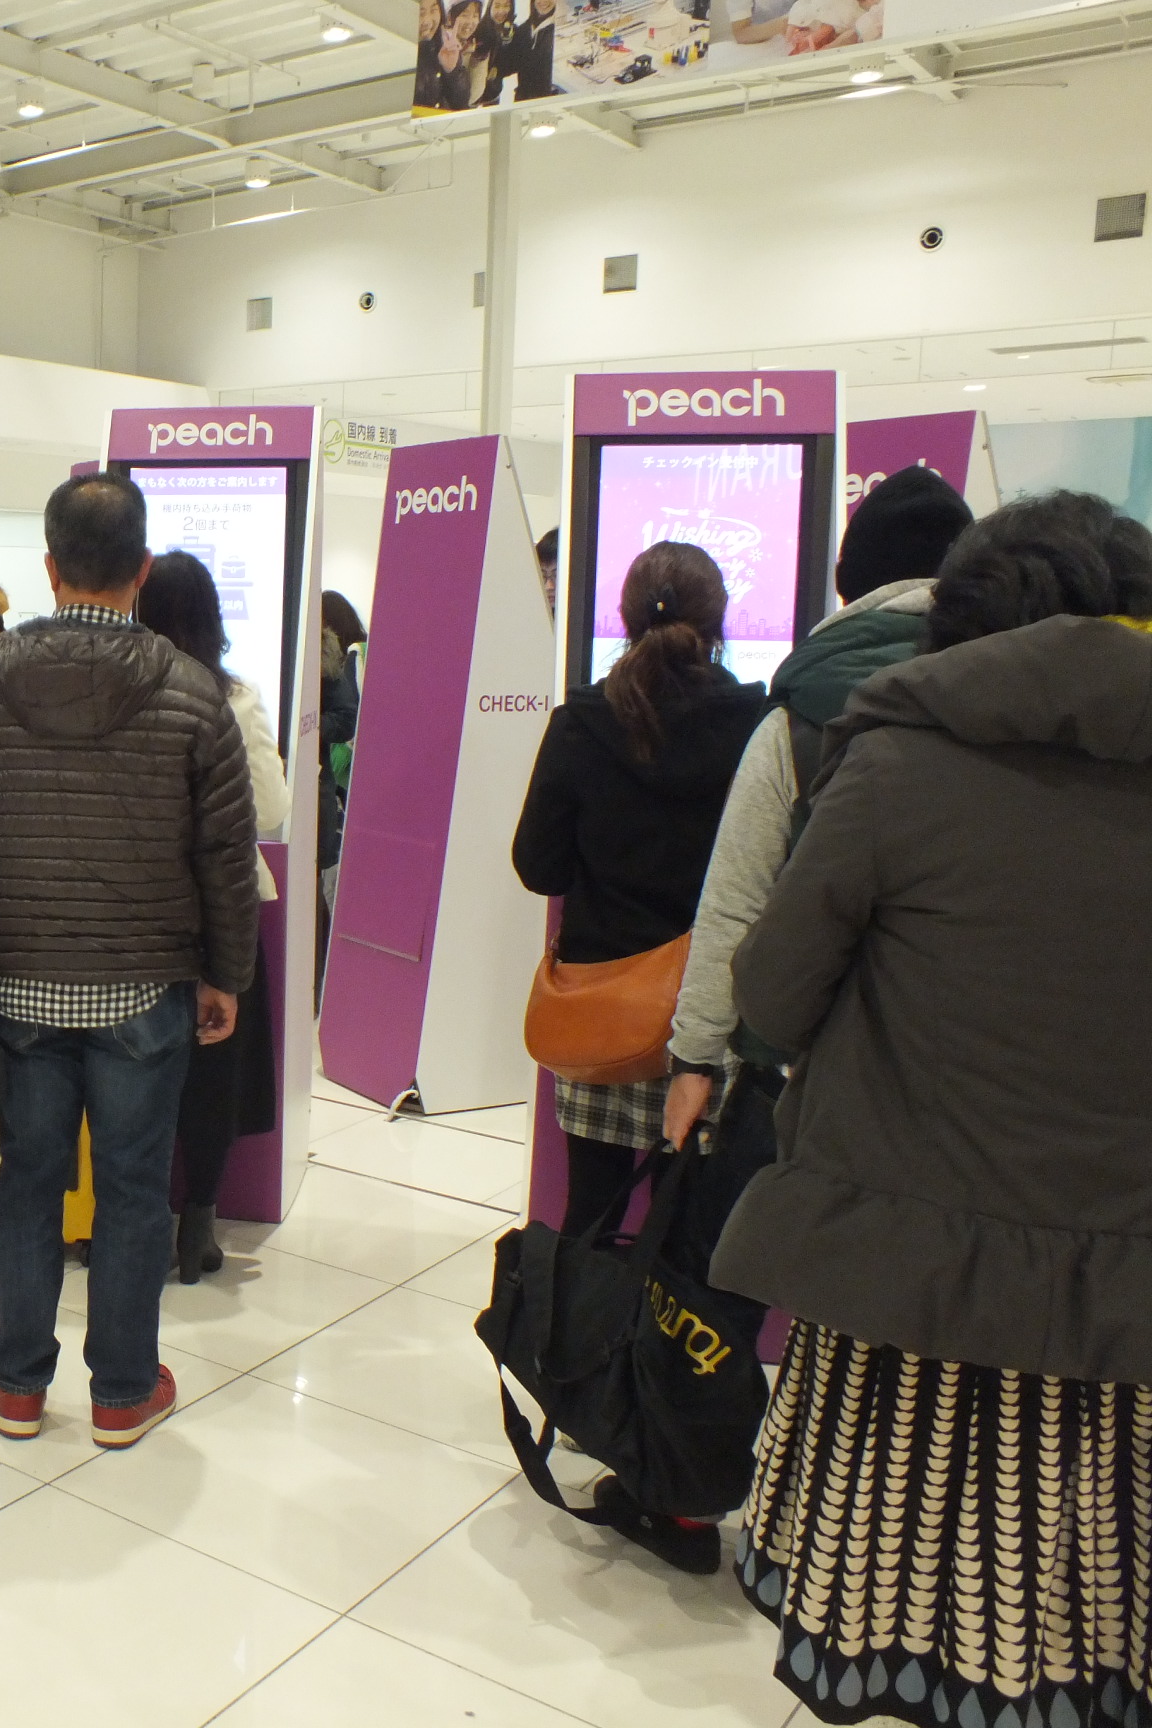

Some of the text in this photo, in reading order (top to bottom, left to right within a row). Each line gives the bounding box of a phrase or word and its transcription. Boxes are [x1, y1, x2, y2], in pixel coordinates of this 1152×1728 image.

[622, 378, 786, 427] peach
[148, 413, 274, 454] peach
[347, 421, 398, 445] 国内線 到着
[347, 447, 389, 463] Domestic Arriva
[642, 455, 759, 469] チェックイン受付中
[138, 476, 278, 488] まもなく次の方をご案内します
[394, 475, 478, 525] peach
[737, 650, 777, 661] peach
[478, 694, 549, 713] CHECK-I
